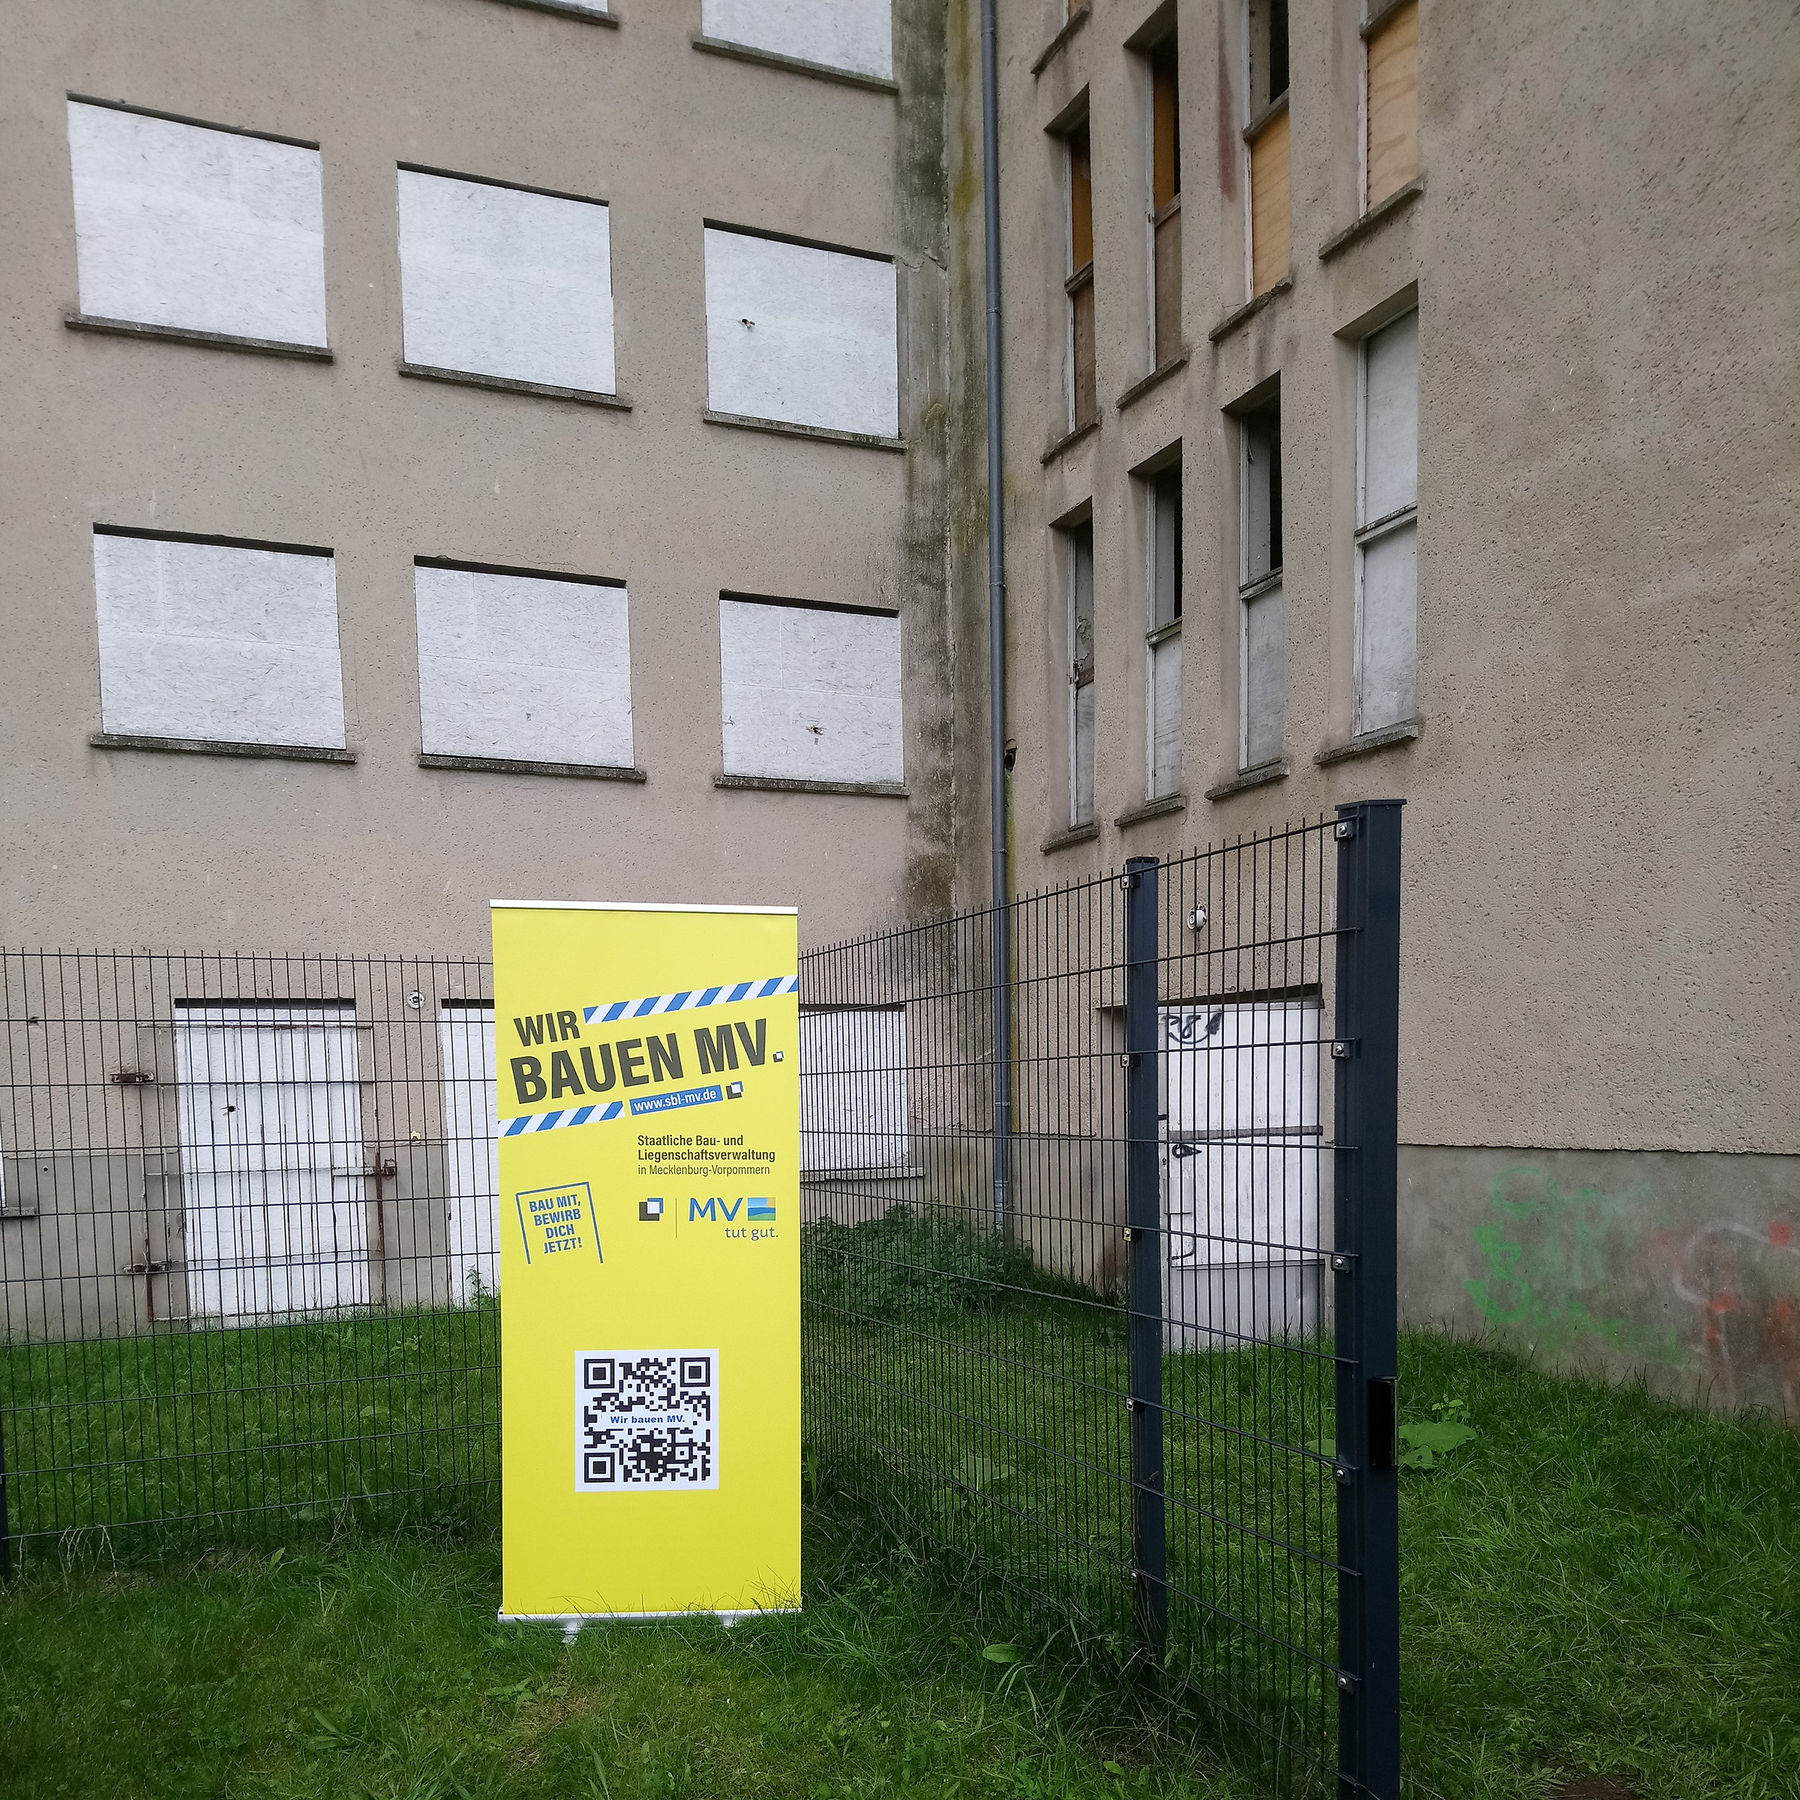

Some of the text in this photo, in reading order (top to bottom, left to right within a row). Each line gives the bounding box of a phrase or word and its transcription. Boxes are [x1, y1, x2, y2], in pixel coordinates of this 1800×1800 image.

[513, 1010, 580, 1047] WIR
[510, 1032, 684, 1104] BAUEN
[634, 1089, 717, 1112] www.sbl-mv.de
[637, 1135, 744, 1146] Staatliche Bau- und
[638, 1149, 776, 1163] Liegenschaftsverwaltung
[638, 1164, 770, 1177] in Mecklenburg-Vorpommern
[529, 1194, 581, 1213] BAU MIT,
[688, 1197, 743, 1222] MV
[534, 1208, 581, 1226] BEWIRB
[545, 1225, 575, 1239] DICH
[725, 1227, 779, 1242] tut gut.
[544, 1238, 583, 1255] JETZT!
[610, 1415, 686, 1424] Wir bauen MV.
